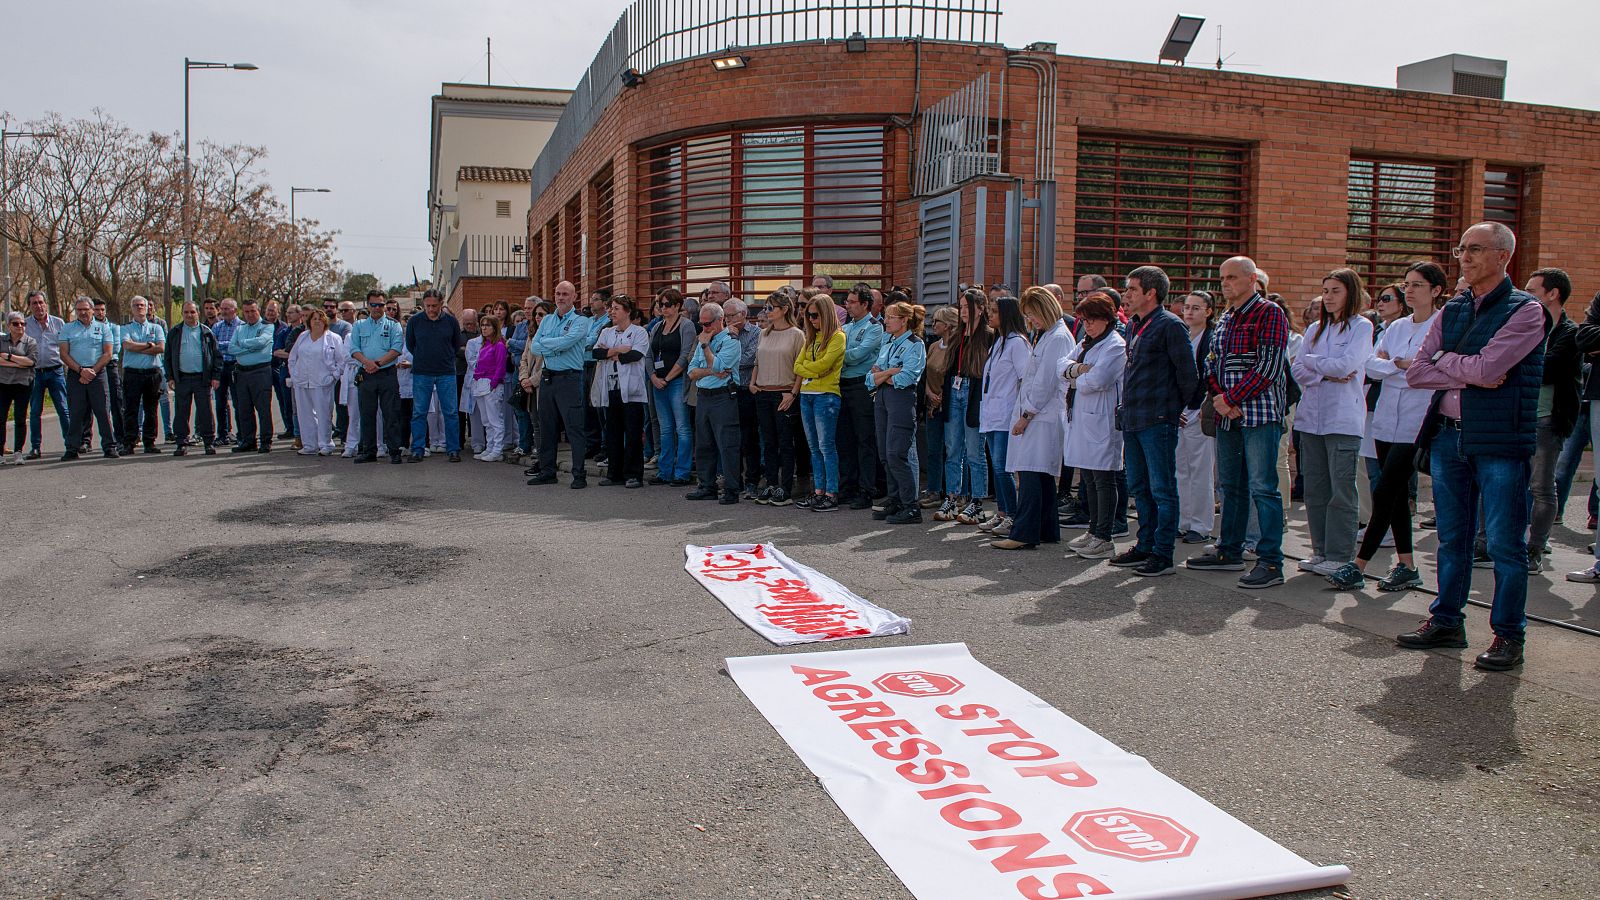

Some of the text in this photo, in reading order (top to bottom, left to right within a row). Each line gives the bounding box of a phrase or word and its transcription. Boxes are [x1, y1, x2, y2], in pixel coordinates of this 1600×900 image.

[897, 674, 940, 693] STOP
[935, 703, 1098, 788] STOP
[790, 665, 1115, 900] AGRESSIONS
[1093, 815, 1168, 852] STOP
